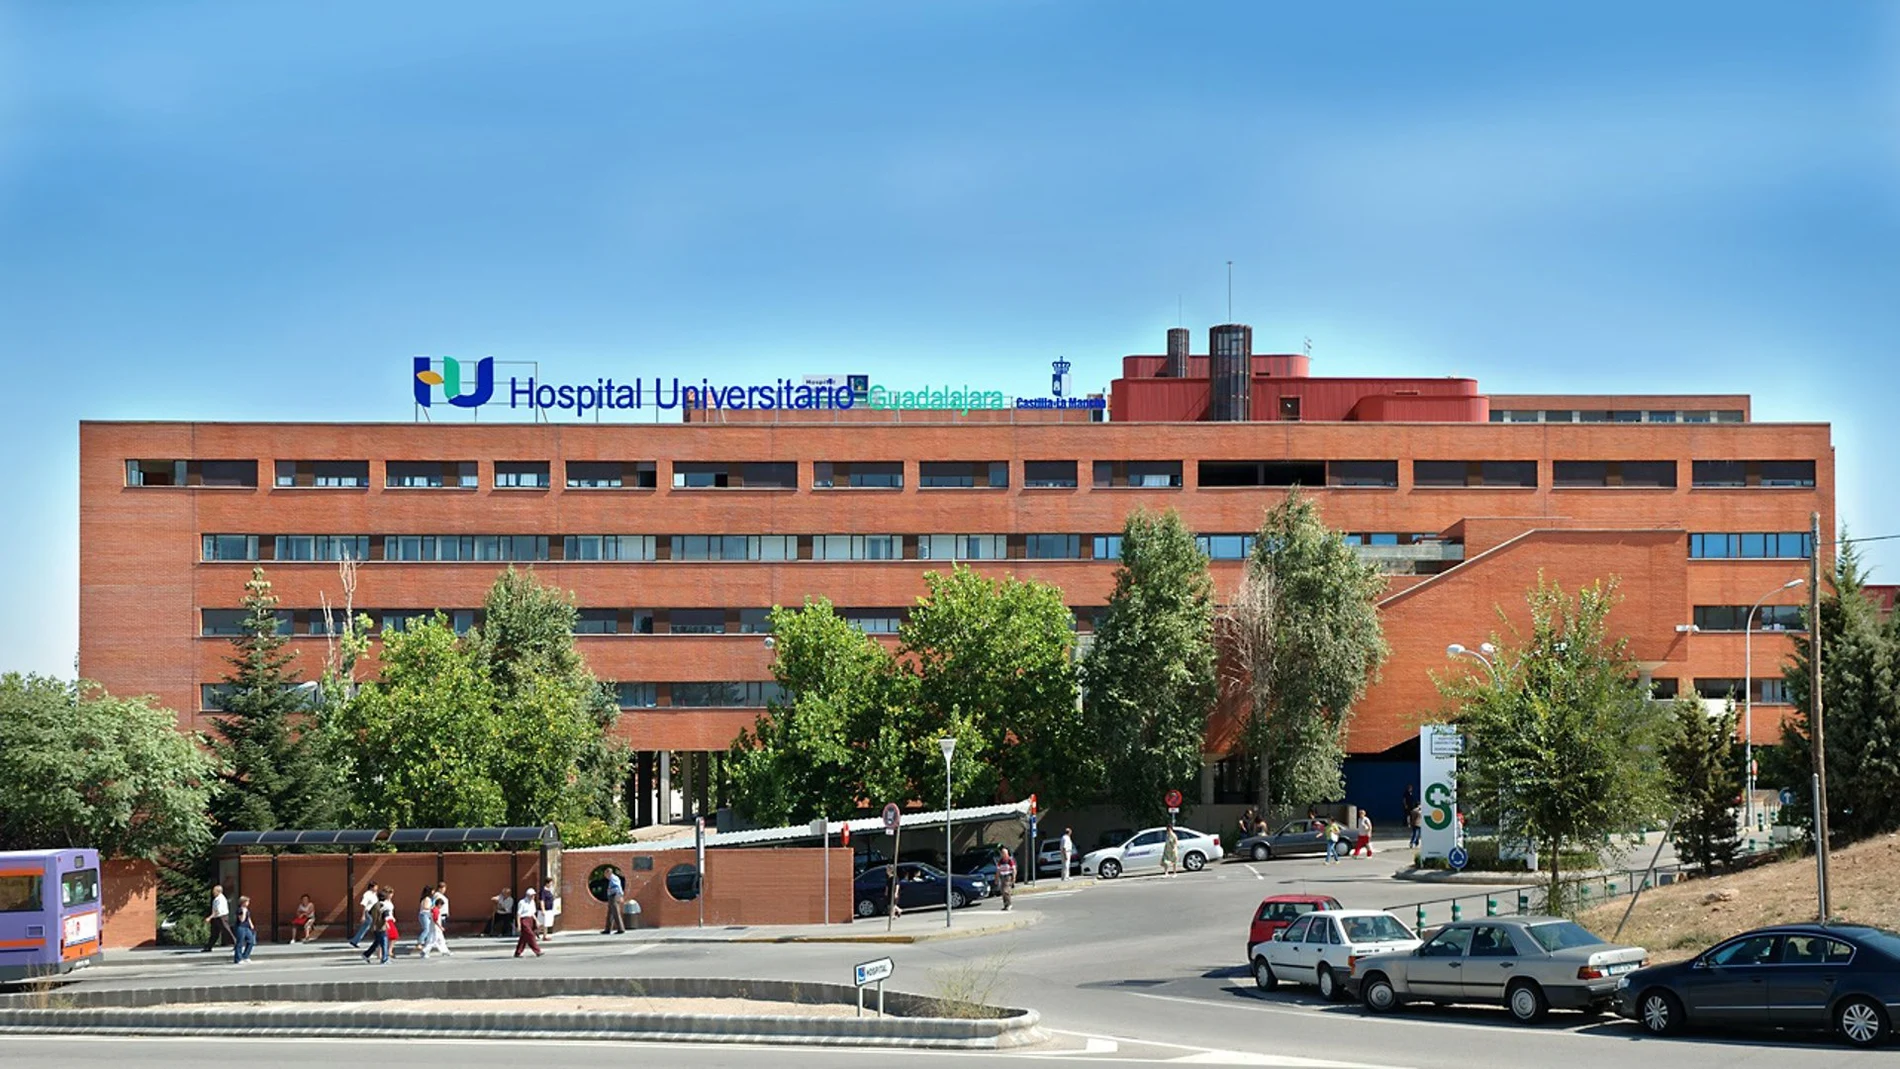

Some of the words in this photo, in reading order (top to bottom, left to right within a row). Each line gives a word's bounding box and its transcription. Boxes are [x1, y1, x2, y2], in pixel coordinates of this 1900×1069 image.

[510, 377, 641, 417] Hospital
[655, 378, 855, 410] Universitario
[868, 385, 1003, 416] Guadalajara
[1068, 397, 1106, 409] Mancha
[866, 964, 887, 976] HOSPITAL
